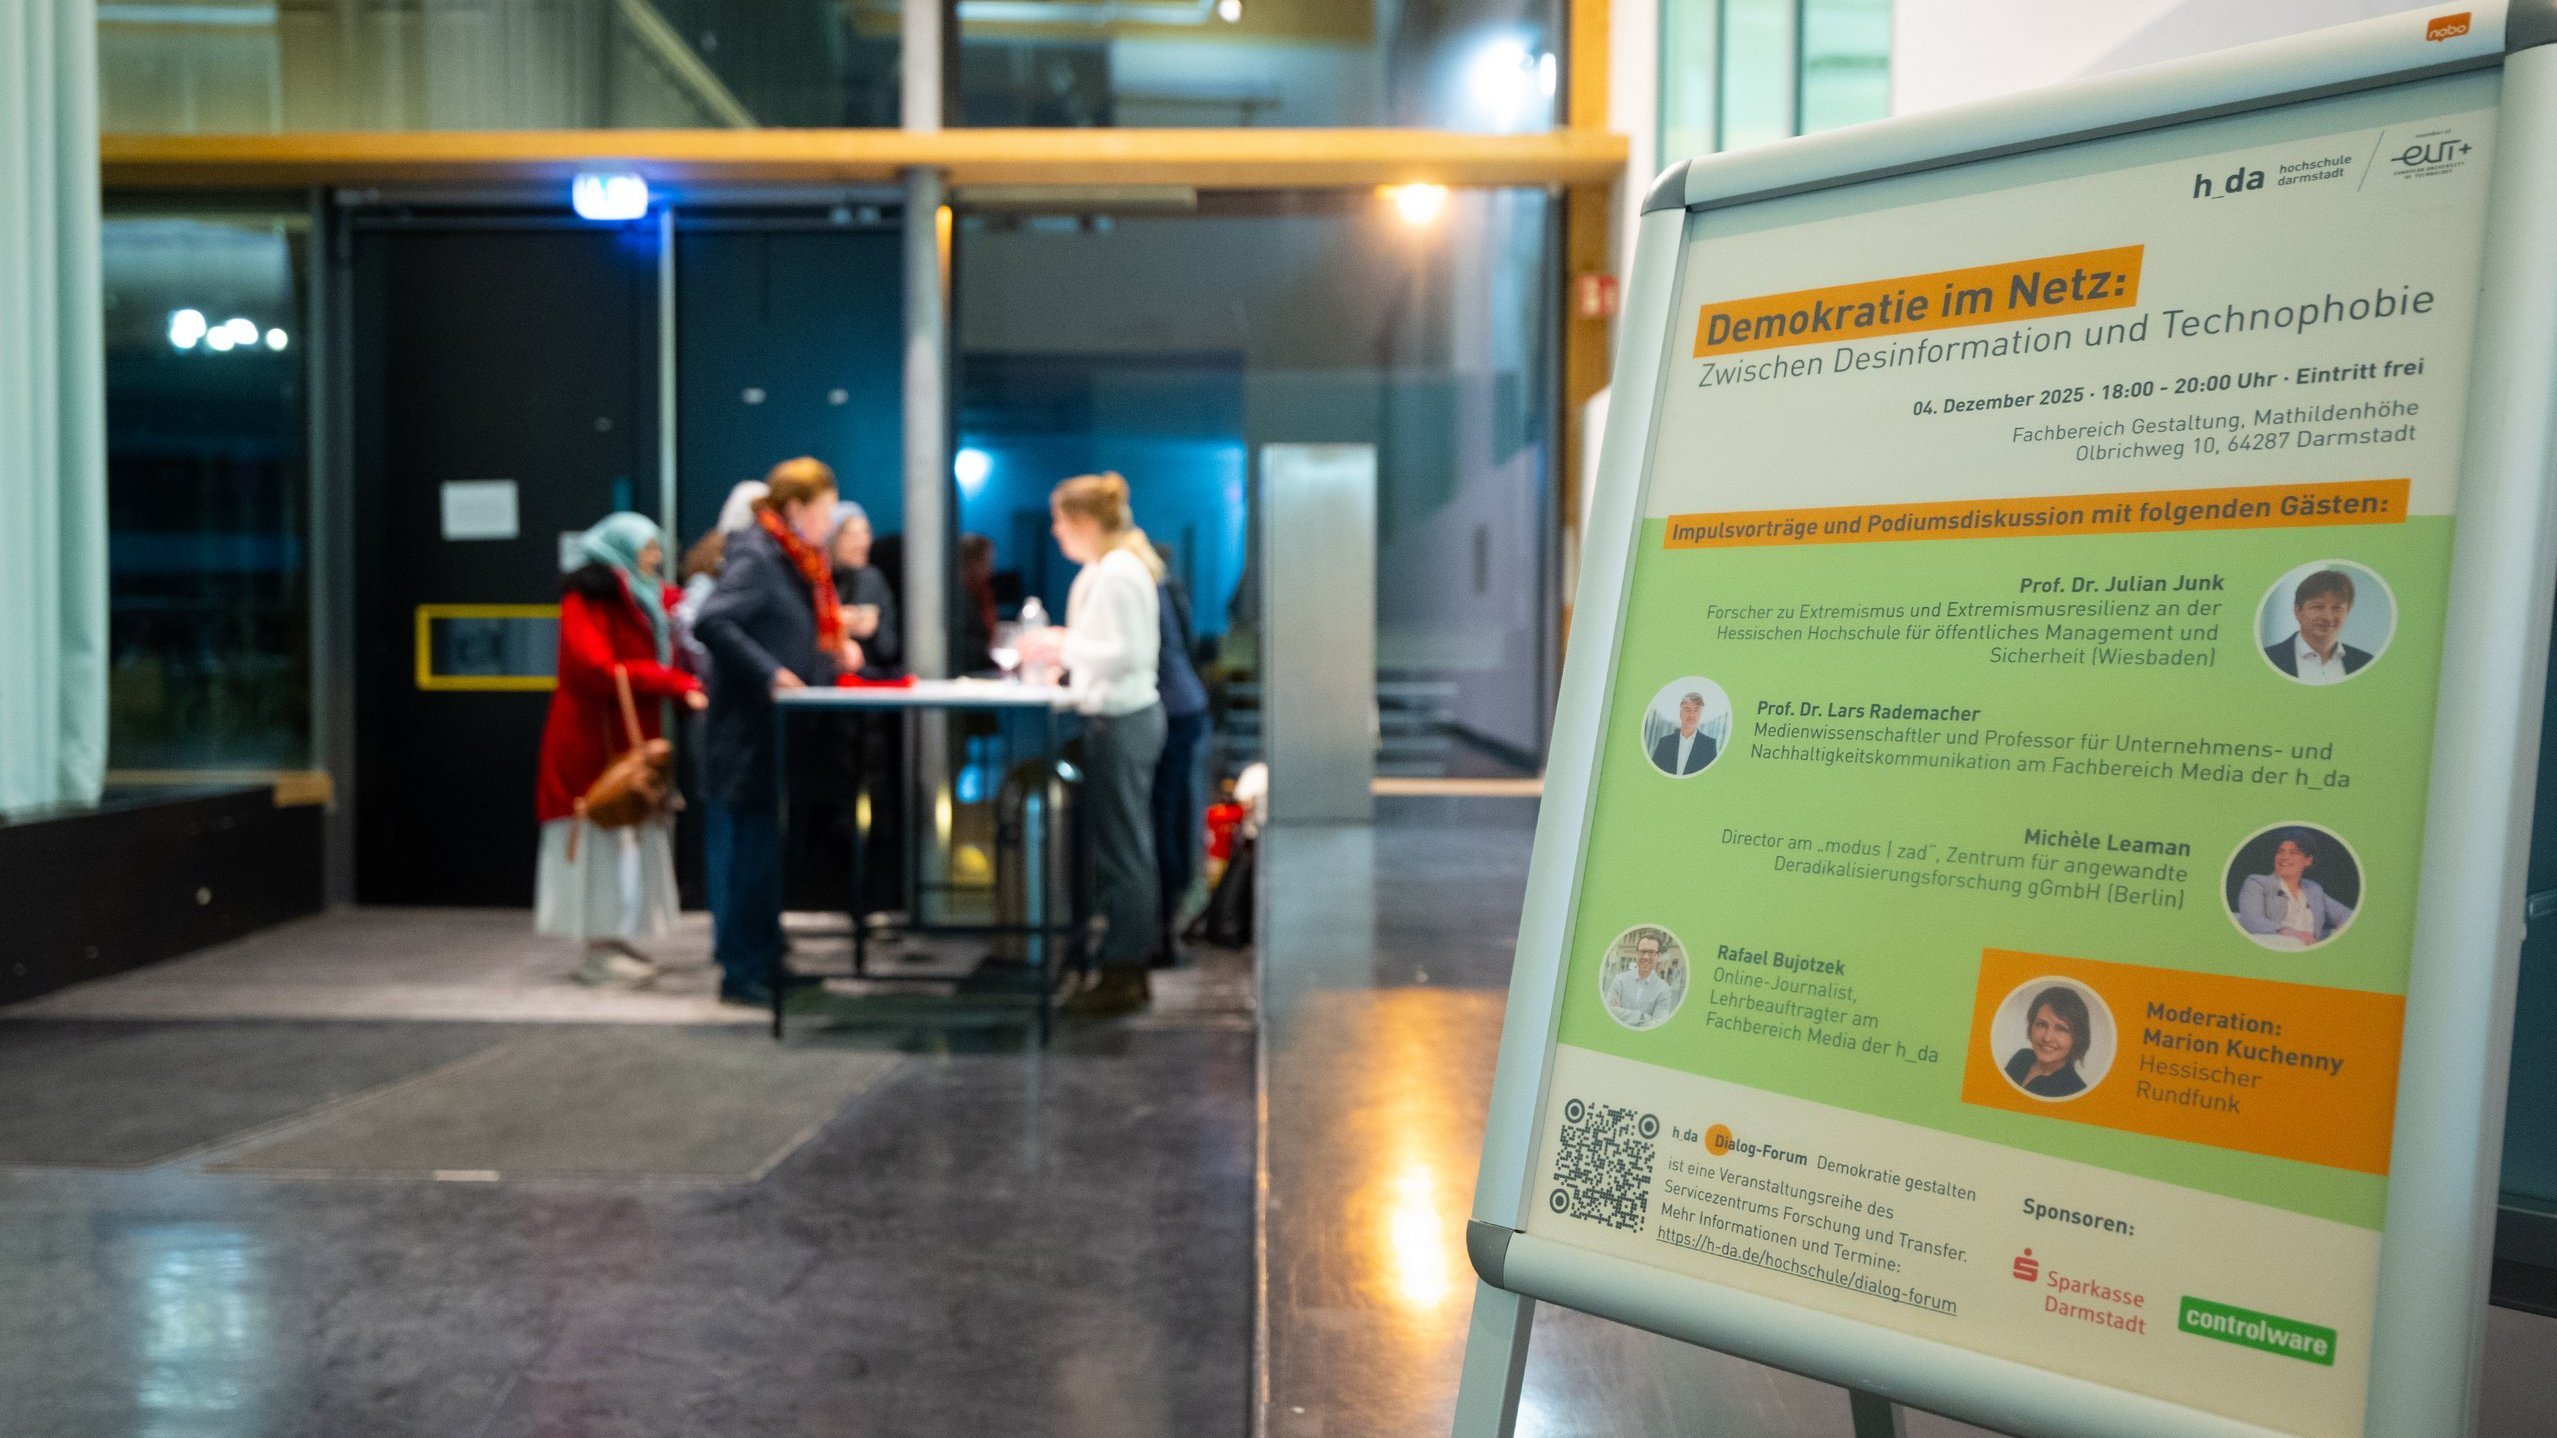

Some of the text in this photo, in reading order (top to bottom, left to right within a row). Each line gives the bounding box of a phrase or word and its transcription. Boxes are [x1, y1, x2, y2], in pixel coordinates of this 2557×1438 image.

[2428, 24, 2467, 40] nobo
[2193, 167, 2265, 199] h_da
[2278, 168, 2345, 187] darmstadt
[2279, 154, 2352, 174] hochschule
[1706, 267, 2126, 346] Demokratie im Netz:
[1699, 285, 2435, 388] Zwischen Desinformation und Technophobie
[1913, 399, 1938, 416] 04.
[1943, 393, 2035, 414] Dezember
[2039, 387, 2084, 406] 2025
[2102, 381, 2155, 401] 18:00
[2174, 374, 2231, 395] 20:00
[2237, 370, 2278, 390] Uhr
[2296, 363, 2377, 386] Eintritt
[2383, 358, 2425, 379] frei
[2013, 400, 2420, 443] Fachbereich Gestaltung, Mathildenhöhe
[2075, 425, 2416, 462] Olbrichweg 10, 64287 Darmstadt
[1671, 495, 2389, 543] Impulsvorträge und Podiumsdiskussion mit folgenden Gästen:
[2020, 574, 2224, 595] Prof. Dr. Julian Junk
[1707, 599, 2222, 620] Forscher zu Extremismus und Extremismusresilienz an der
[1717, 623, 2219, 645] Hessischen Hochschule für öffentliches Management und
[1990, 647, 2216, 667] Sicherheit (Wiesbaden)
[1757, 701, 1981, 722] Prof. Dr. Lars Rademacher
[1754, 723, 2333, 760] Medienwissenschaftler und Professor für Unternehmens- und
[1751, 744, 2351, 790] Nachhaltigkeitskommunikation am Fachbereich Media der h_da
[1721, 829, 1784, 849] Director
[1788, 837, 1813, 851] am
[1946, 847, 2025, 869] Zentrum
[2031, 854, 2059, 872] für
[2064, 858, 2188, 883] angewandte
[2024, 828, 2191, 857] Michèle Leaman
[1774, 855, 2185, 911] Deradikalisierungsforschung gGmbH (Berlin)
[1717, 945, 1846, 977] Rafael Bujotzek
[1713, 966, 1857, 1004] Online-Journalist,
[1709, 989, 1879, 1029] Lehrbeauftragter am
[2146, 1001, 2282, 1037] Moderation:
[1706, 1011, 1939, 1064] Fachbereich Media der h_da
[2143, 1028, 2344, 1077] Marion Kuchenny
[2139, 1053, 2263, 1089] Hessischer
[2136, 1080, 2241, 1114] Rundfunk
[1672, 1126, 1976, 1202] h_da Dialog-Forum Demokratie gestalten
[1668, 1157, 1895, 1220] ist eine Veranstaltungsreihe des
[1664, 1179, 1968, 1263] Servicezentrums Forschung und Transfer.
[2023, 1198, 2135, 1236] Sponsoren:
[1661, 1202, 1902, 1273] Mehr Informationen und Termine:
[1656, 1225, 1958, 1316] https://h-da.de/hochschule/dialog-forum
[2047, 1270, 2145, 1308] Sparkasse
[2044, 1295, 2147, 1335] Darmstadt
[2186, 1307, 2328, 1357] controlware
